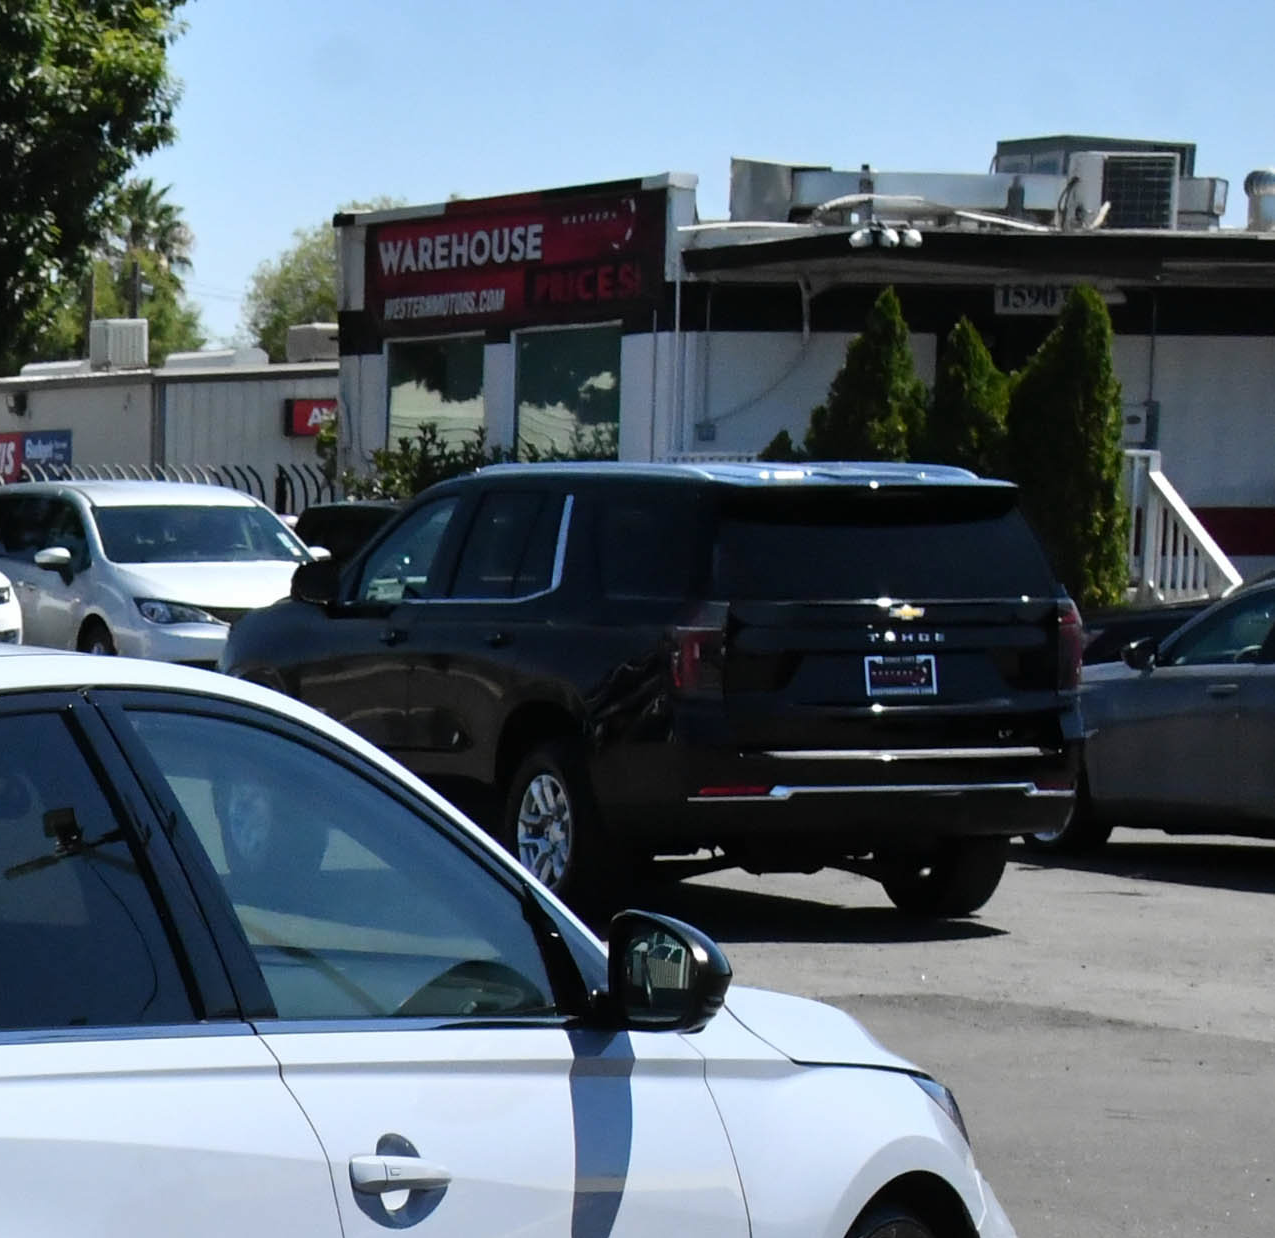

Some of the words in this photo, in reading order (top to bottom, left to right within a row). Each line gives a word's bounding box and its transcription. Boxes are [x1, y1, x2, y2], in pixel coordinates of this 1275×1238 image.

[378, 223, 544, 276] WAREHOUSE
[384, 288, 505, 320] WESTERNMOTORS.COM
[867, 631, 945, 643] THOE
